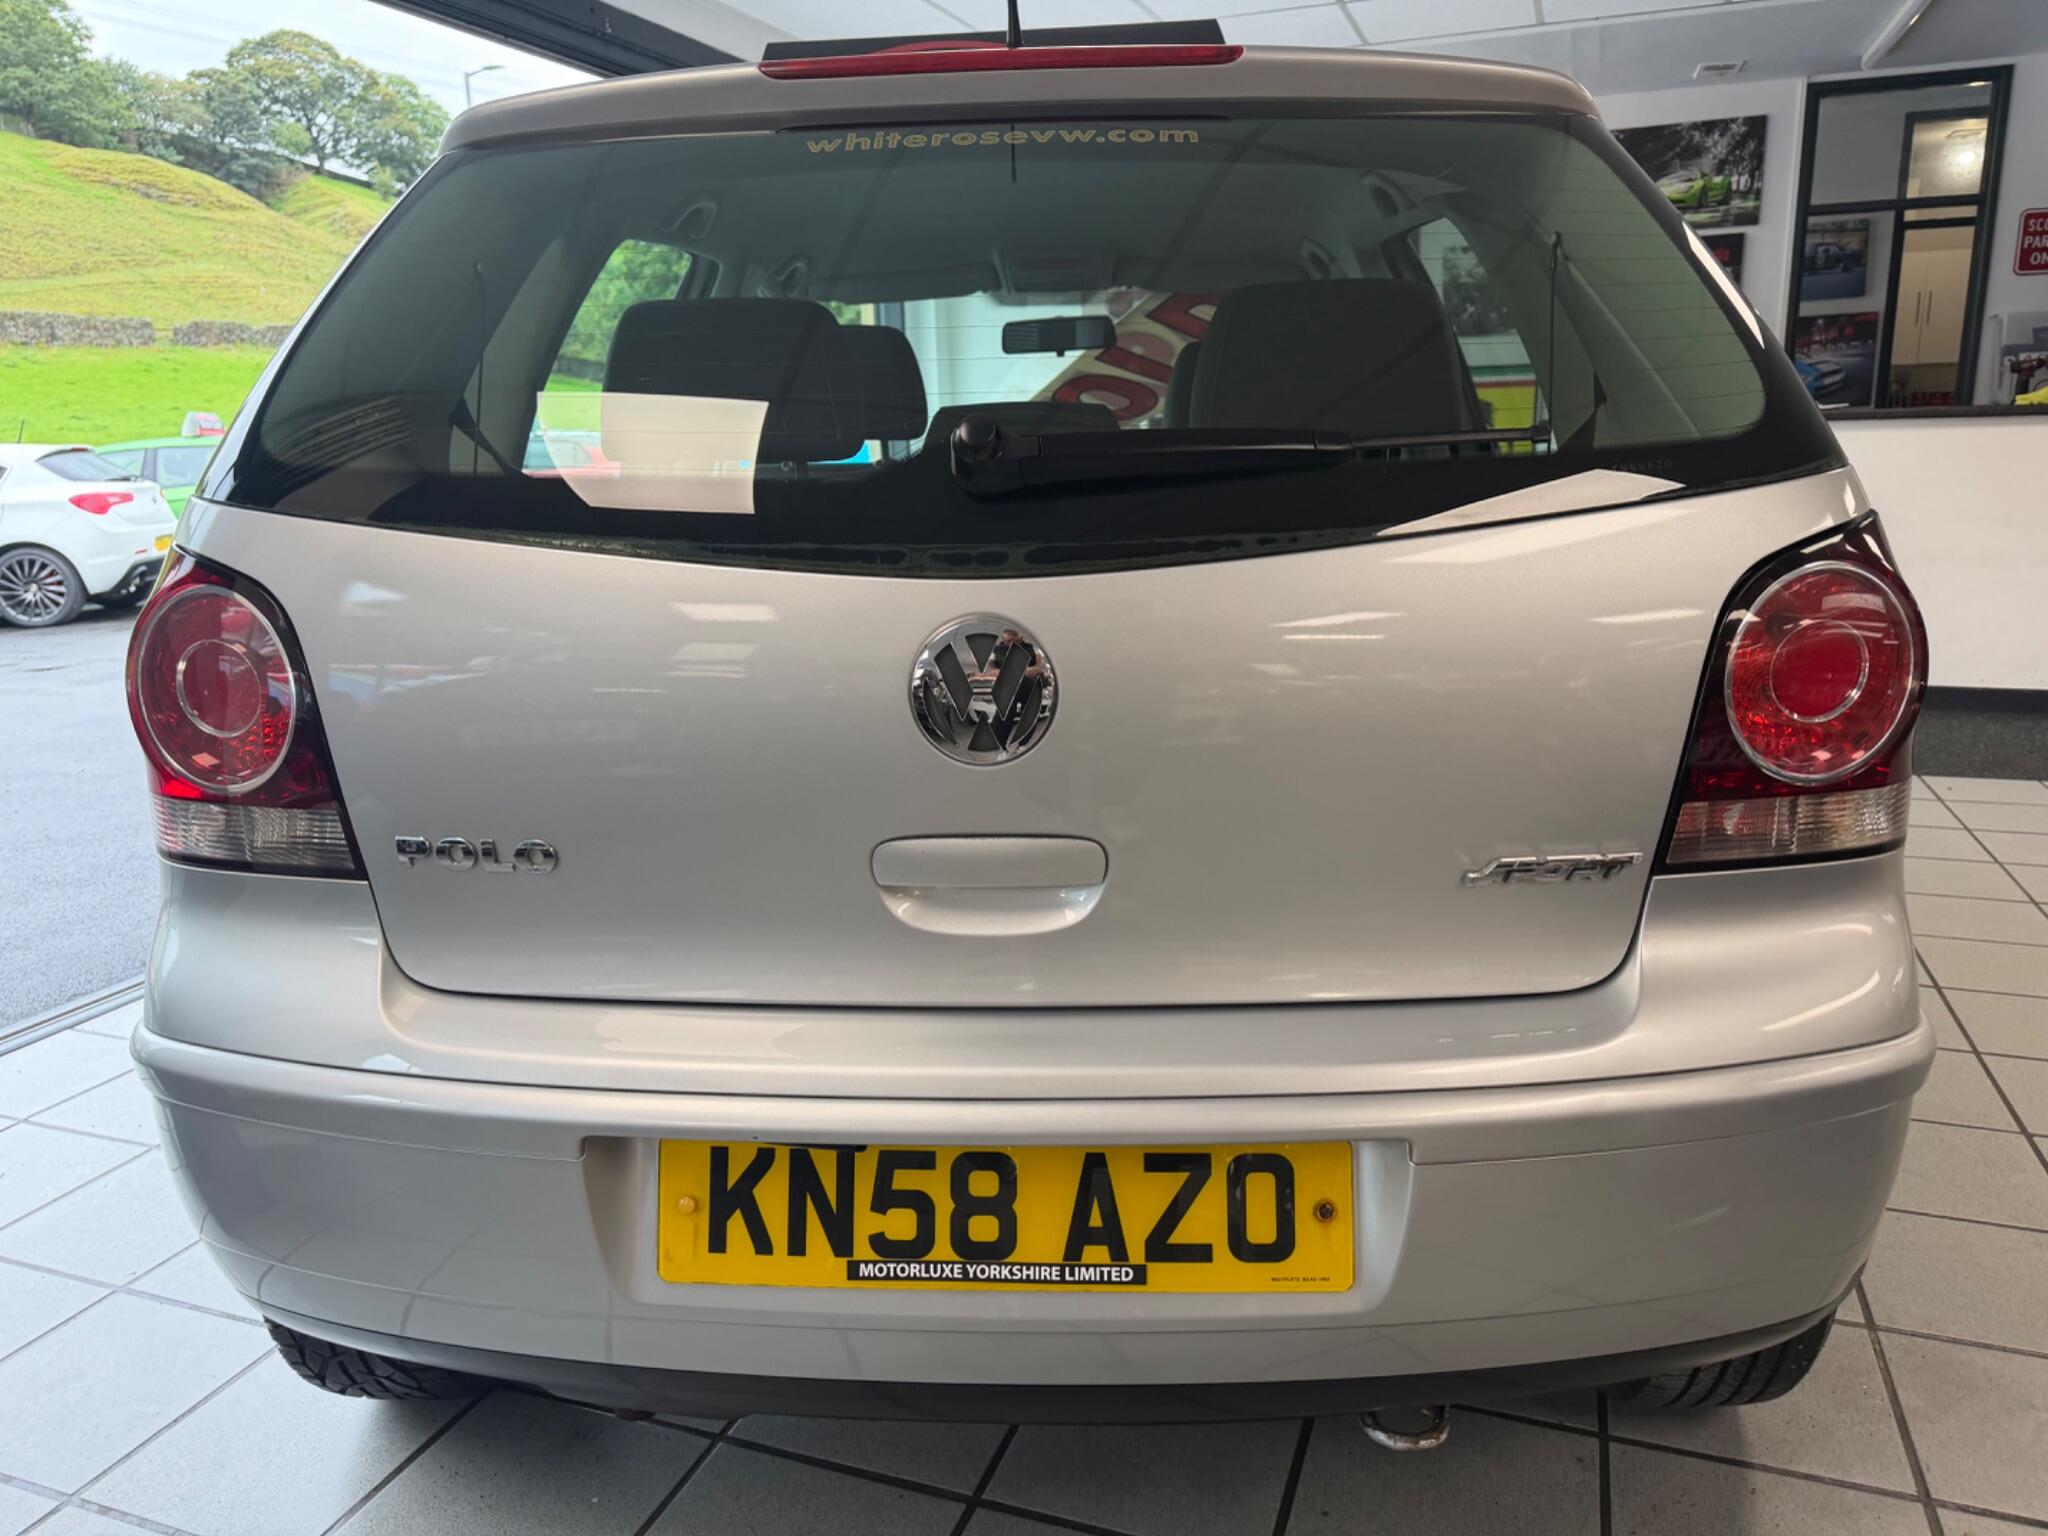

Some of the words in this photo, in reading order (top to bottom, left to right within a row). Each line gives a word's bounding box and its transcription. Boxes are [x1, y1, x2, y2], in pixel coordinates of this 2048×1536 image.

[806, 128, 1199, 153] whiterosevw.com
[395, 834, 559, 875] POLO
[708, 1146, 1018, 1261] KN58
[1062, 1153, 1296, 1263] AZO
[858, 1262, 963, 1279] MOTORLUXE
[965, 1264, 1061, 1282] YORKSHIRE
[1064, 1266, 1135, 1283] LIMITED
